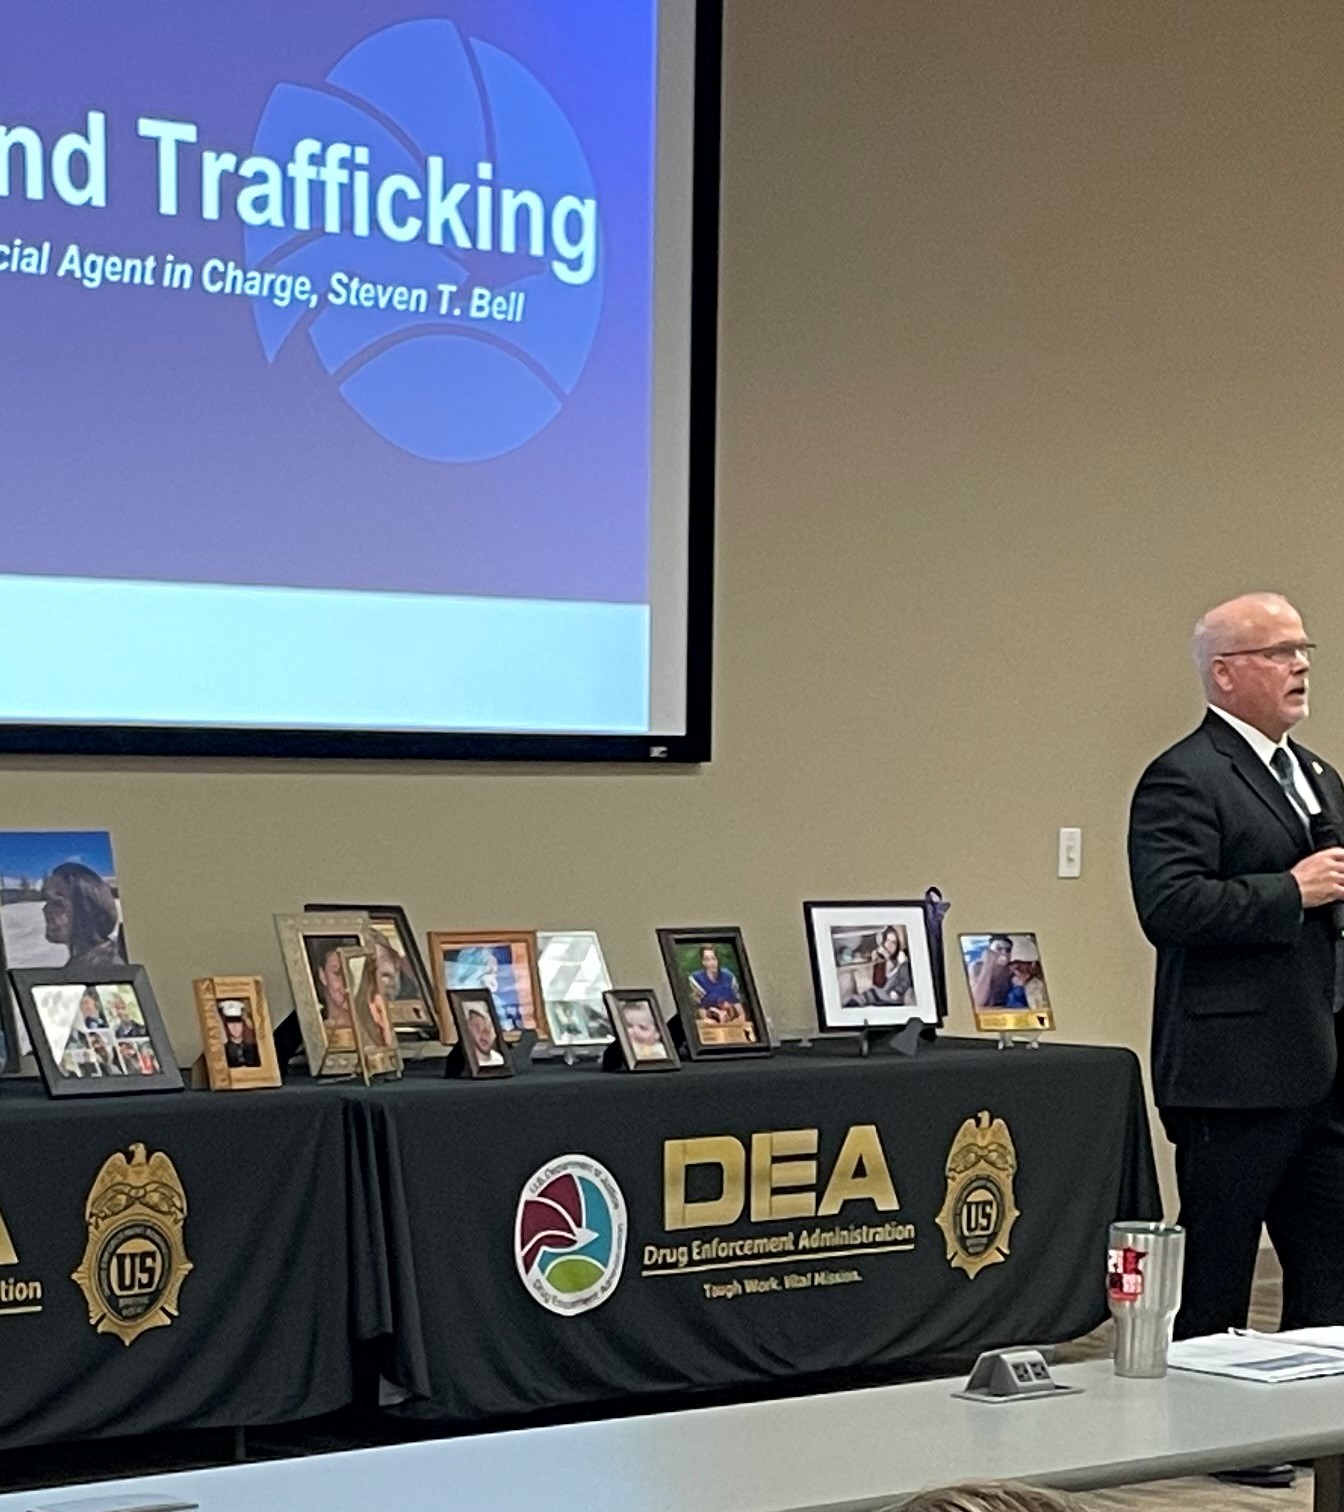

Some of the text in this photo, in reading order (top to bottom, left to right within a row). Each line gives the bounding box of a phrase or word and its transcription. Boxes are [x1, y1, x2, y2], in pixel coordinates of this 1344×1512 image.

[138, 117, 598, 285] Trafficking
[57, 244, 156, 289] Agent
[163, 253, 193, 289] in
[202, 258, 319, 309] Charge,
[328, 270, 428, 313] Steven
[437, 284, 462, 317] T.
[469, 287, 525, 322] Bell
[663, 1123, 900, 1232] DEA
[642, 1220, 915, 1270] Drug Enforcement Administration
[963, 1200, 994, 1233] US
[115, 1250, 157, 1292] US
